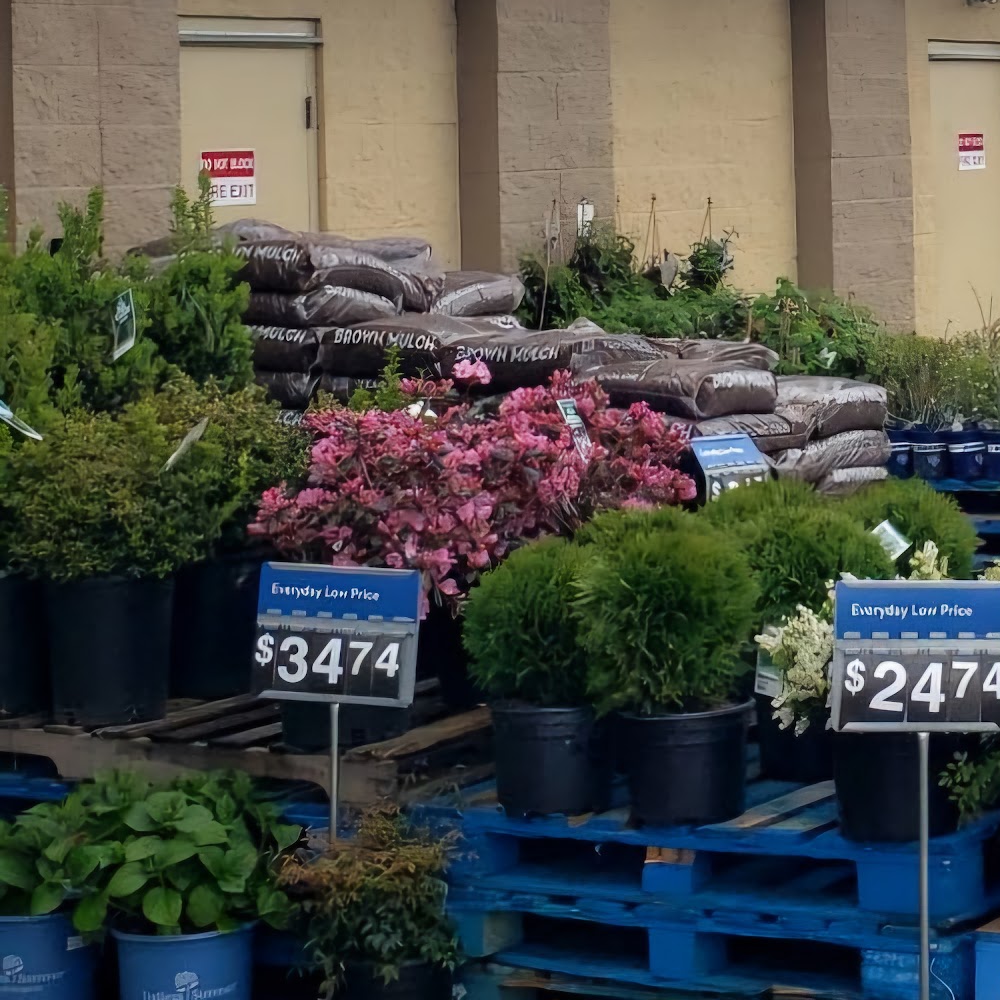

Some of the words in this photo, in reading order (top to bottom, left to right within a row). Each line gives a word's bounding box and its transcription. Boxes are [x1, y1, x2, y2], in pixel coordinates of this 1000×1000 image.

[230, 184, 254, 198] EXIT
[333, 327, 385, 345] BROWN
[386, 331, 437, 350] MULCH
[454, 345, 508, 362] BROWN
[509, 345, 559, 363] MULCH
[271, 582, 322, 599] Everyday
[324, 585, 348, 599] Low
[350, 587, 381, 602] Price
[851, 603, 909, 620] Everyday
[911, 604, 938, 616] Low
[940, 604, 974, 617] Price
